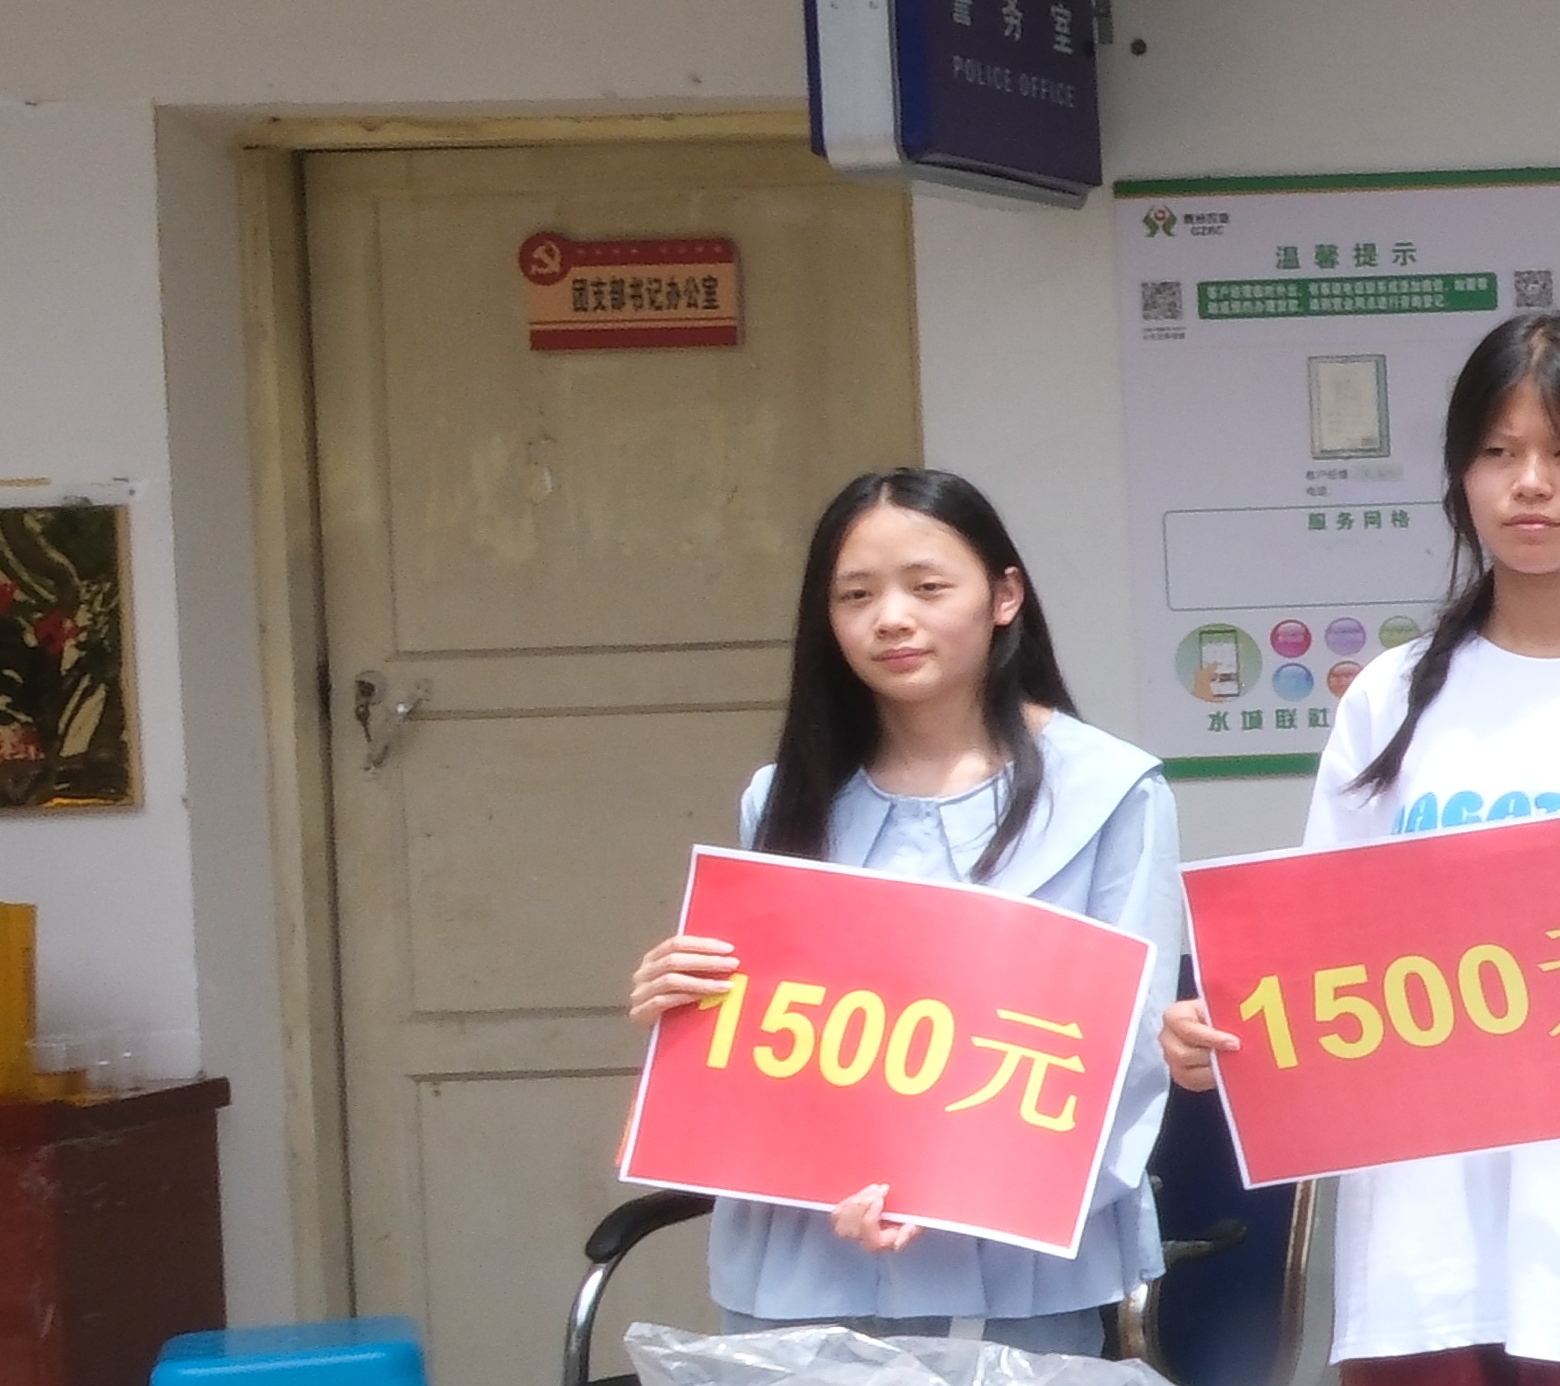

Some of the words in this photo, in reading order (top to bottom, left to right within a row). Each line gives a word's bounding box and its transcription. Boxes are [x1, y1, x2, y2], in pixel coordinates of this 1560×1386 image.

[953, 54, 1013, 93] POLICE
[1018, 72, 1075, 108] OFFICE
[1275, 242, 1417, 270] 温馨提示
[571, 273, 720, 312] 团支部书记办公室
[1308, 509, 1410, 531] 服务网格
[697, 971, 1087, 1134] 1500元
